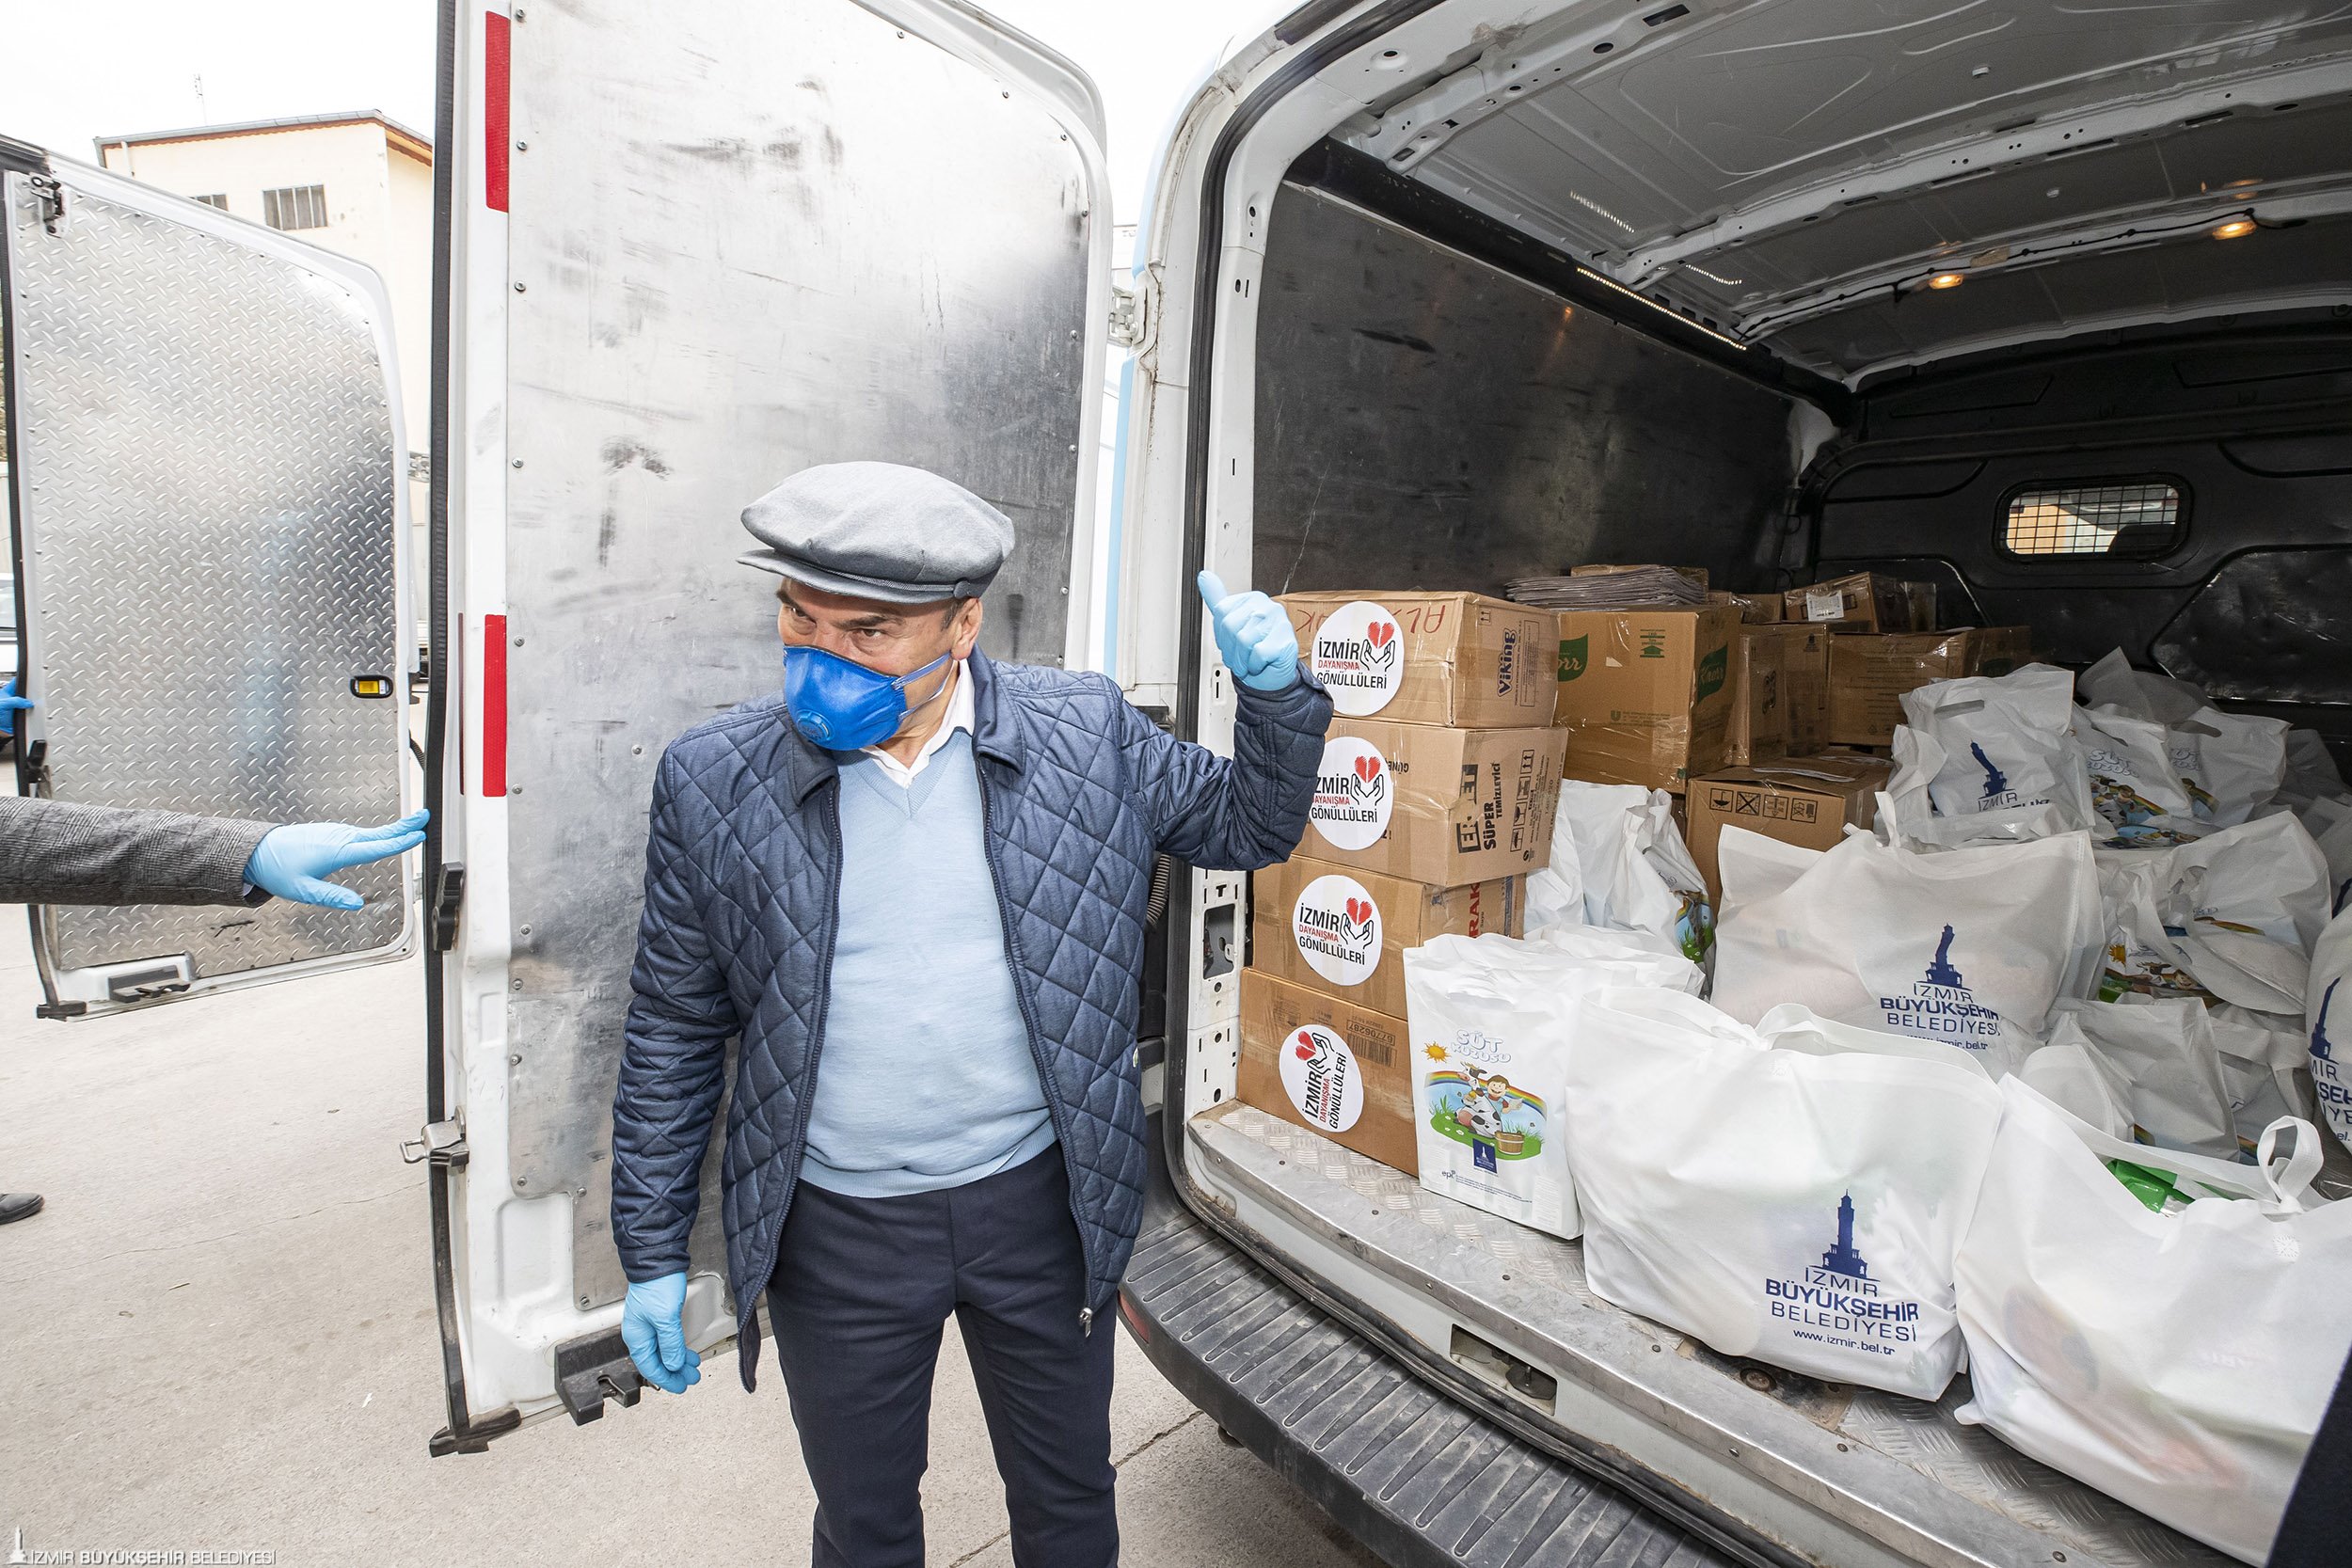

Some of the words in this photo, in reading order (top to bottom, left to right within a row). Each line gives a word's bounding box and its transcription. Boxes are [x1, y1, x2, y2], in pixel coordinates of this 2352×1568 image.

[1319, 637, 1360, 660] İZMİR
[1318, 659, 1360, 672] DAYANIŞMA
[1498, 628, 1517, 696] Viking
[1317, 670, 1387, 689] GÖNÜLLÜLERİ
[1385, 758, 1409, 775] GÜNE
[1315, 773, 1350, 795] ZMİR
[1313, 795, 1350, 807] AYANIŞMA
[1311, 804, 1378, 823] GÖNÜLLÜLERİ
[1483, 802, 1497, 850] SÜPER
[1299, 902, 1340, 932] İZMİR
[1298, 924, 1340, 942] DAYANIŞMA
[1299, 935, 1365, 965] GÖNÜLLÜLERİ
[1887, 1012, 2001, 1036] BELEDİYESİ
[1451, 1042, 1512, 1063] KUZUSU
[1456, 1029, 1504, 1053] SÜT
[1302, 1071, 1323, 1118] İZMİR
[1319, 1078, 1331, 1123] DAYANIŞMA
[1327, 1053, 1347, 1130] GÖNÜLLÜLERİ
[1765, 1277, 1919, 1323] BÜYÜKŞEHİR
[1772, 1301, 1917, 1342] BELEDİYESİ
[1792, 1329, 1896, 1355] www.izmir.bel.tr
